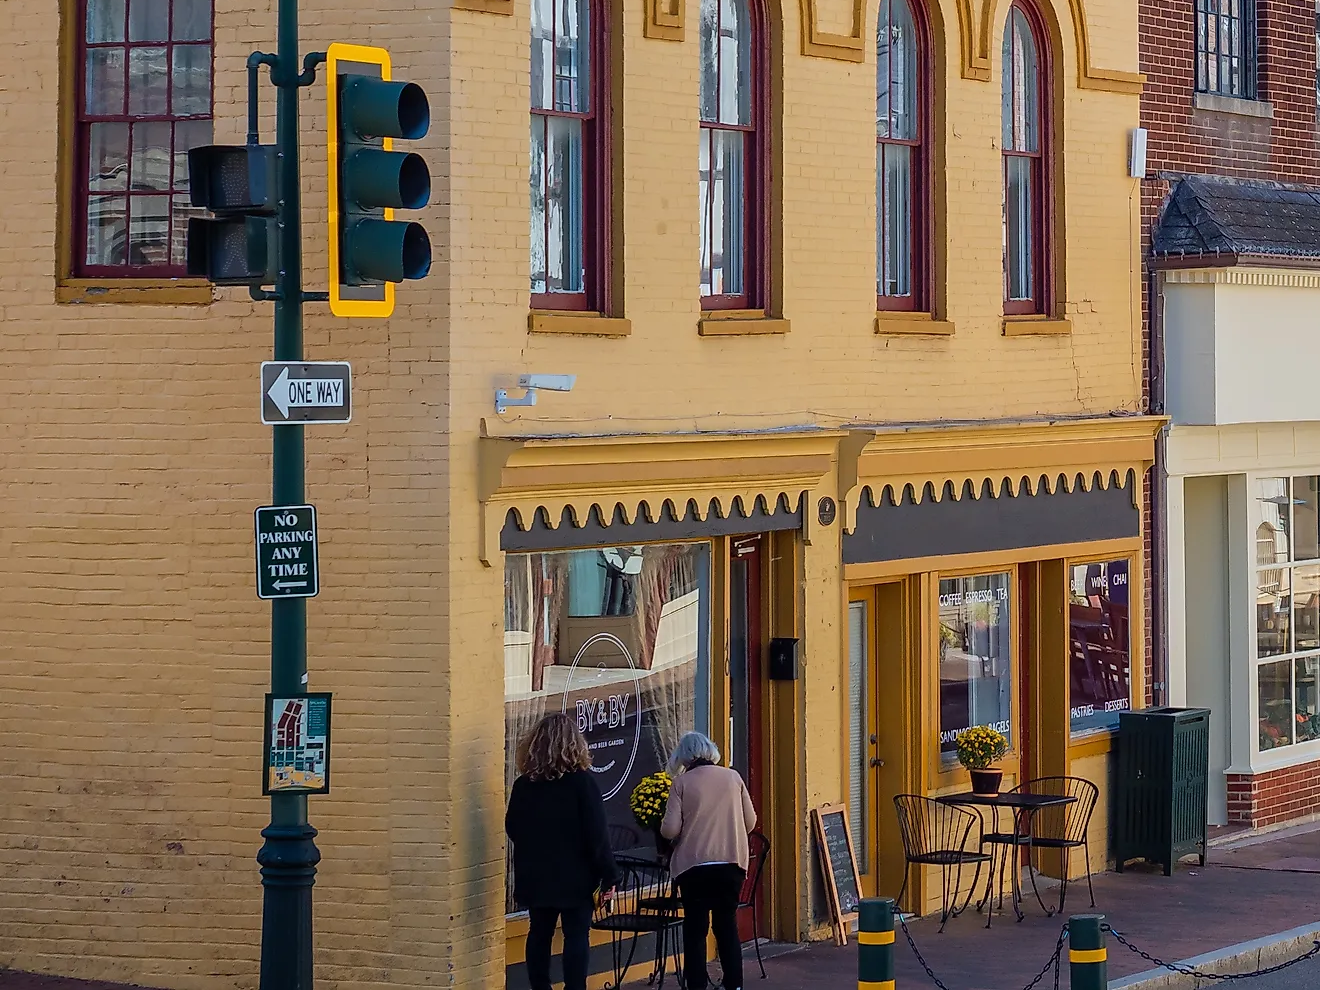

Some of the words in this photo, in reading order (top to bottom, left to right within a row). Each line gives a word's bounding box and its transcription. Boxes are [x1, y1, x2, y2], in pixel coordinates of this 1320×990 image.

[289, 382, 312, 403] ONE
[317, 382, 341, 403] WAY
[274, 514, 298, 527] NO
[260, 530, 313, 544] PARKING
[272, 547, 302, 560] ANY
[268, 563, 309, 577] TIME
[1091, 576, 1107, 588] WINE
[1112, 573, 1127, 586] CHAI
[938, 592, 961, 607] COFFEE
[965, 589, 993, 604] ESPRESSO
[996, 588, 1008, 601] TEA
[576, 698, 597, 733] BY
[597, 701, 608, 725] &
[608, 692, 630, 729] BY
[1071, 704, 1094, 718] PASTRIES
[1104, 698, 1128, 712] DESSERTS
[608, 738, 625, 748] GARDEN
